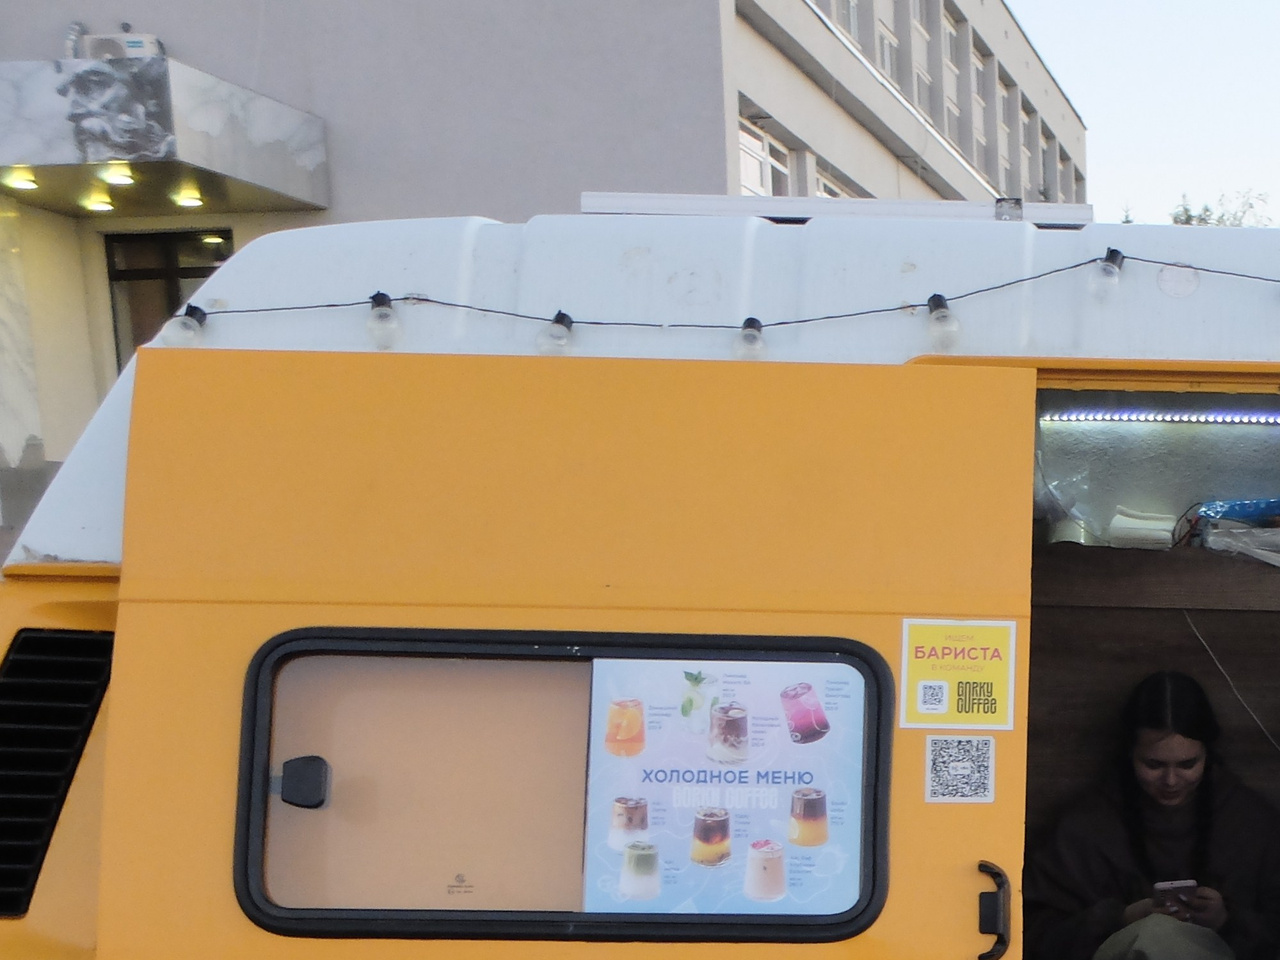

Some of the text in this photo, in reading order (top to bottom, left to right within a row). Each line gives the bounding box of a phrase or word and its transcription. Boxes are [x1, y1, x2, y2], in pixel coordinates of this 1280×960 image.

[914, 646, 1003, 661] БАРИСТА
[642, 769, 814, 785] ХОЛОДНОЕ МЕНЮ
